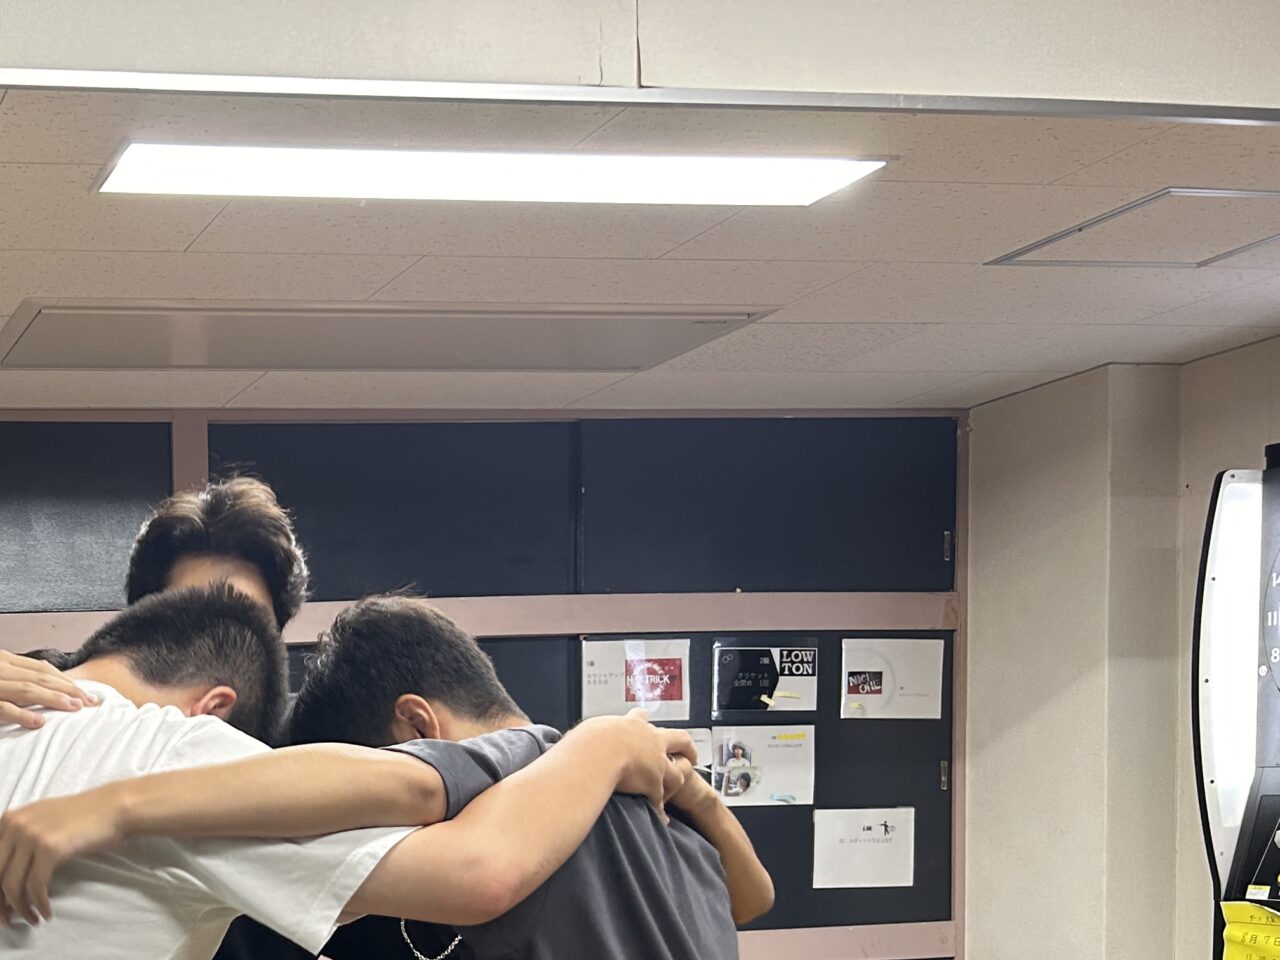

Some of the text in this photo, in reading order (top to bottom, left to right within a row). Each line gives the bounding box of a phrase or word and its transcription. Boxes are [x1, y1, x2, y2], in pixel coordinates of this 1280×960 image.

[1267, 611, 1278, 626] 11
[781, 650, 815, 662] LOW
[1270, 647, 1280, 662] 8
[781, 663, 814, 675] TON
